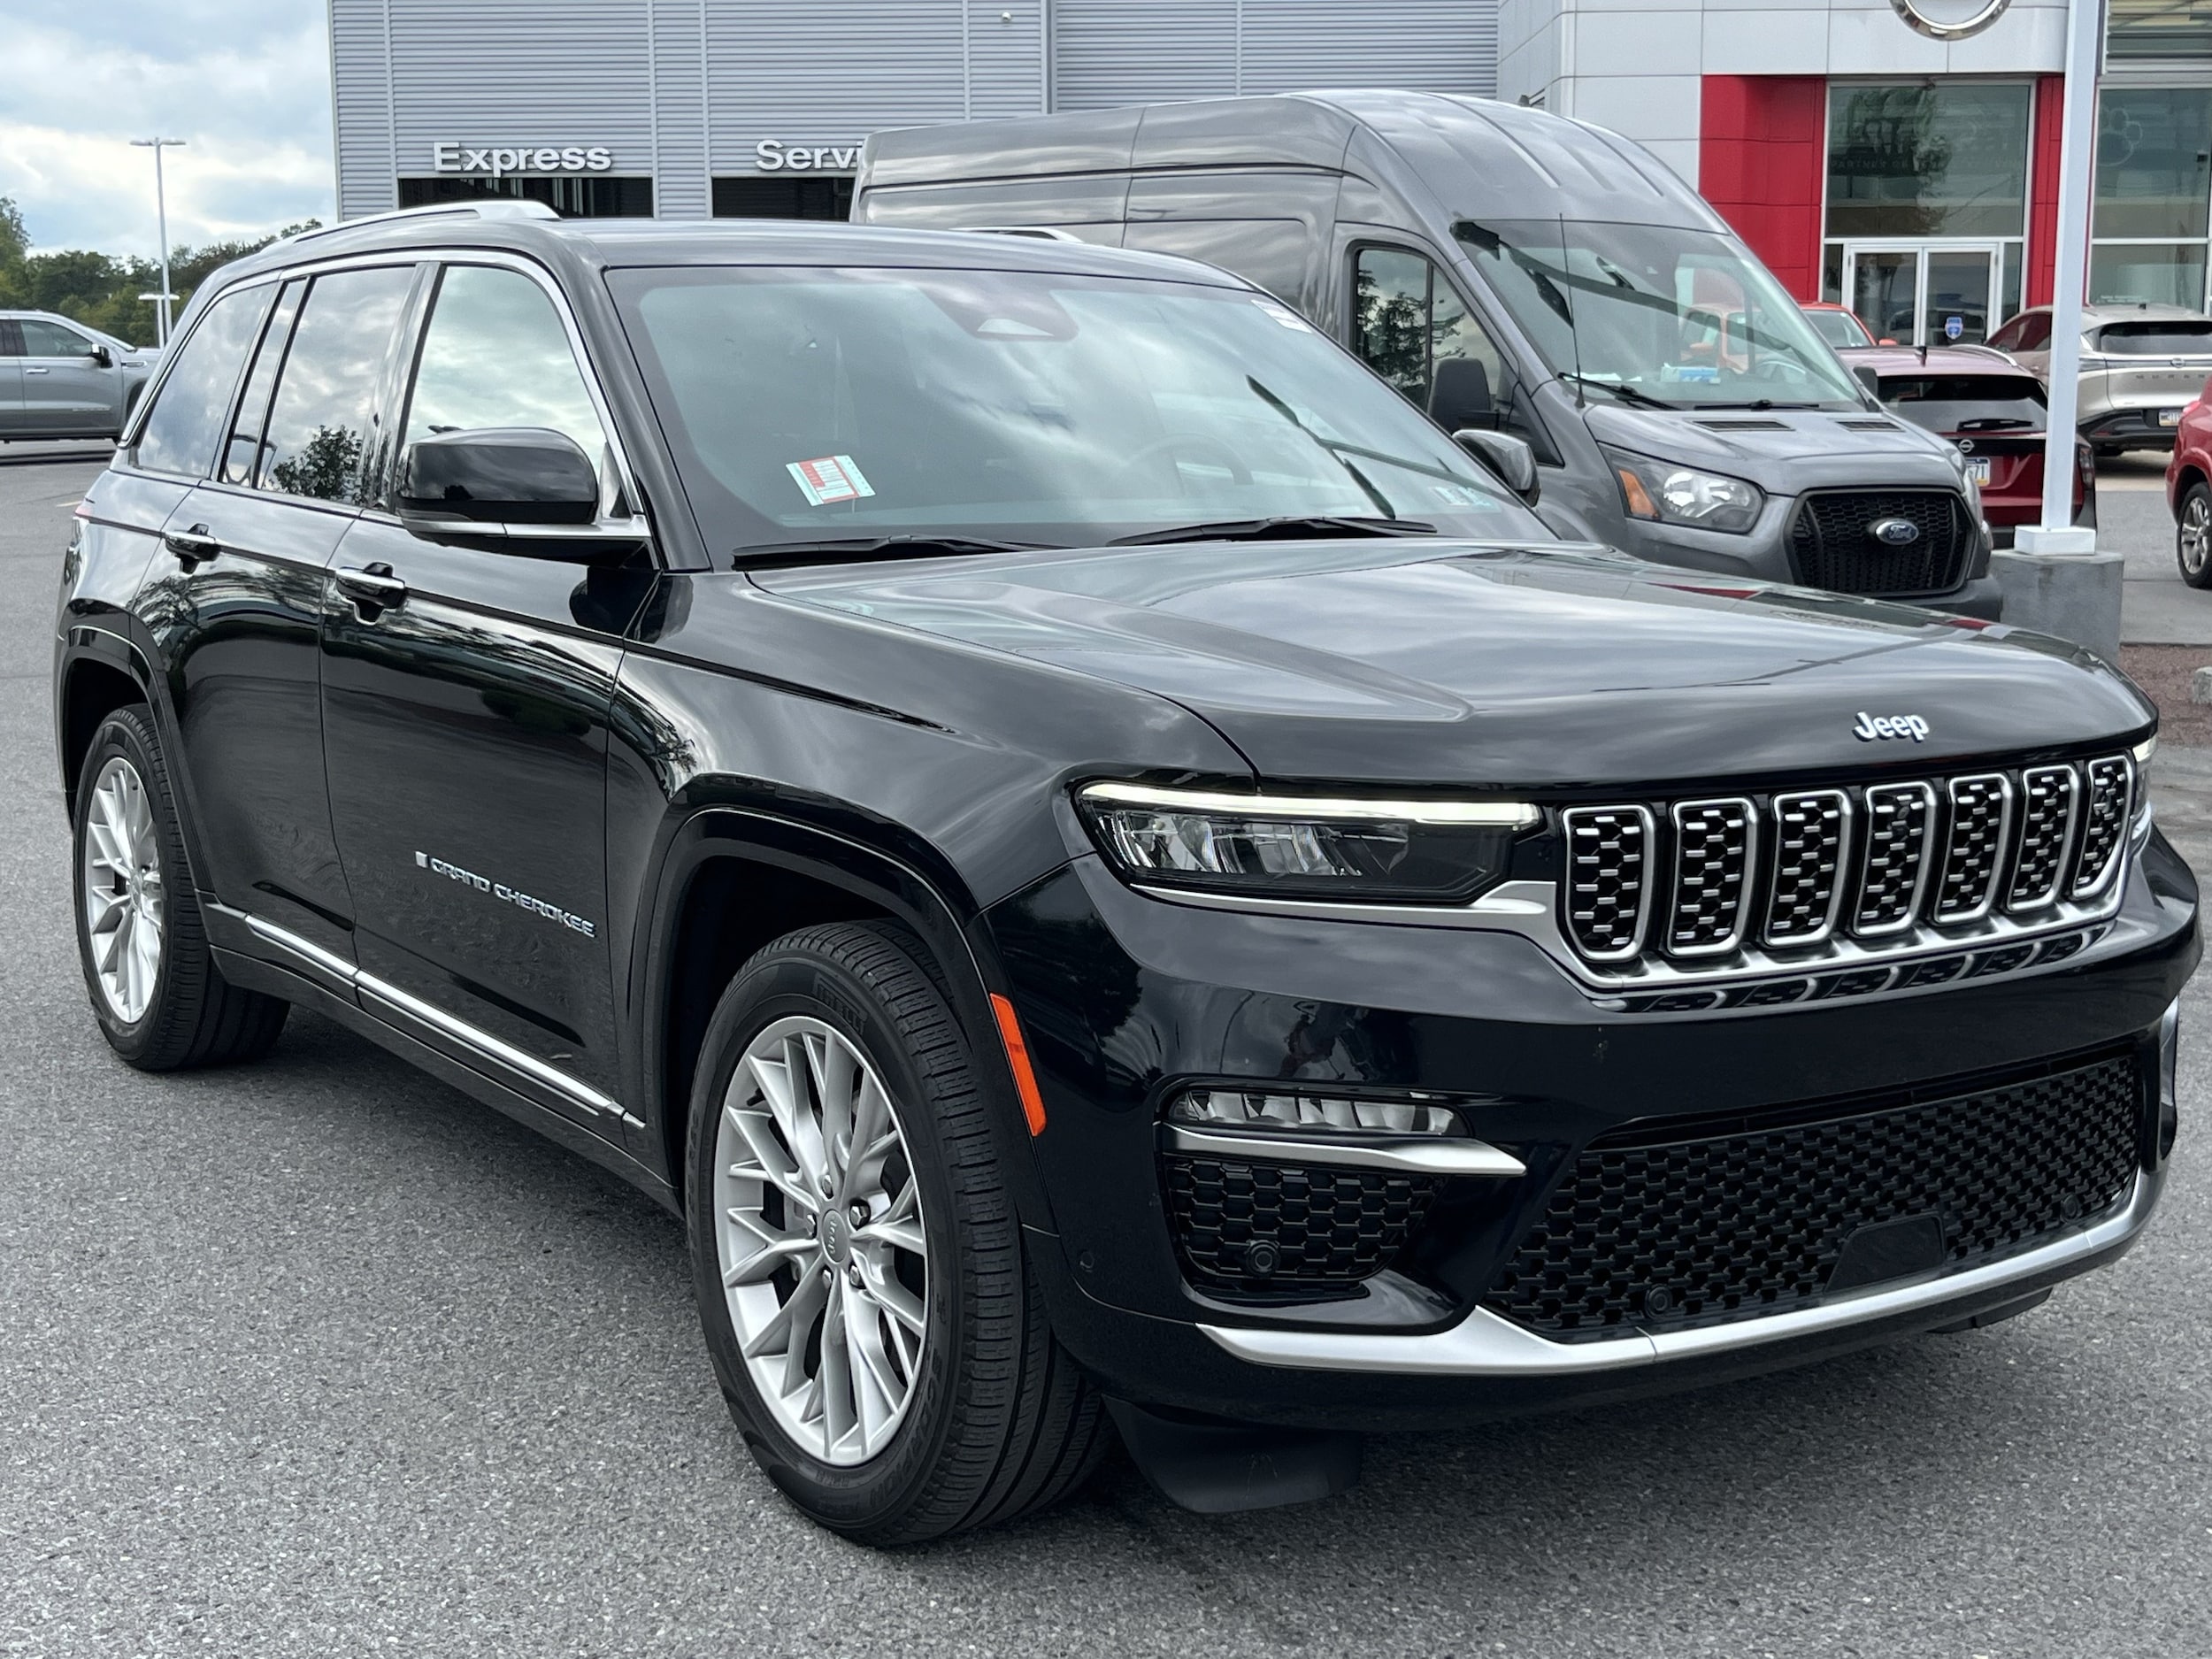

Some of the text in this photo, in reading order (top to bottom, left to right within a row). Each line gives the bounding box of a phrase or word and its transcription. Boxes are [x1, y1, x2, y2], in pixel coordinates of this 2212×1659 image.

[433, 142, 612, 178] Express
[1888, 524, 1913, 540] Ford
[1854, 710, 1930, 741] Jeep
[430, 857, 597, 939] GRAND CHEROKEE
